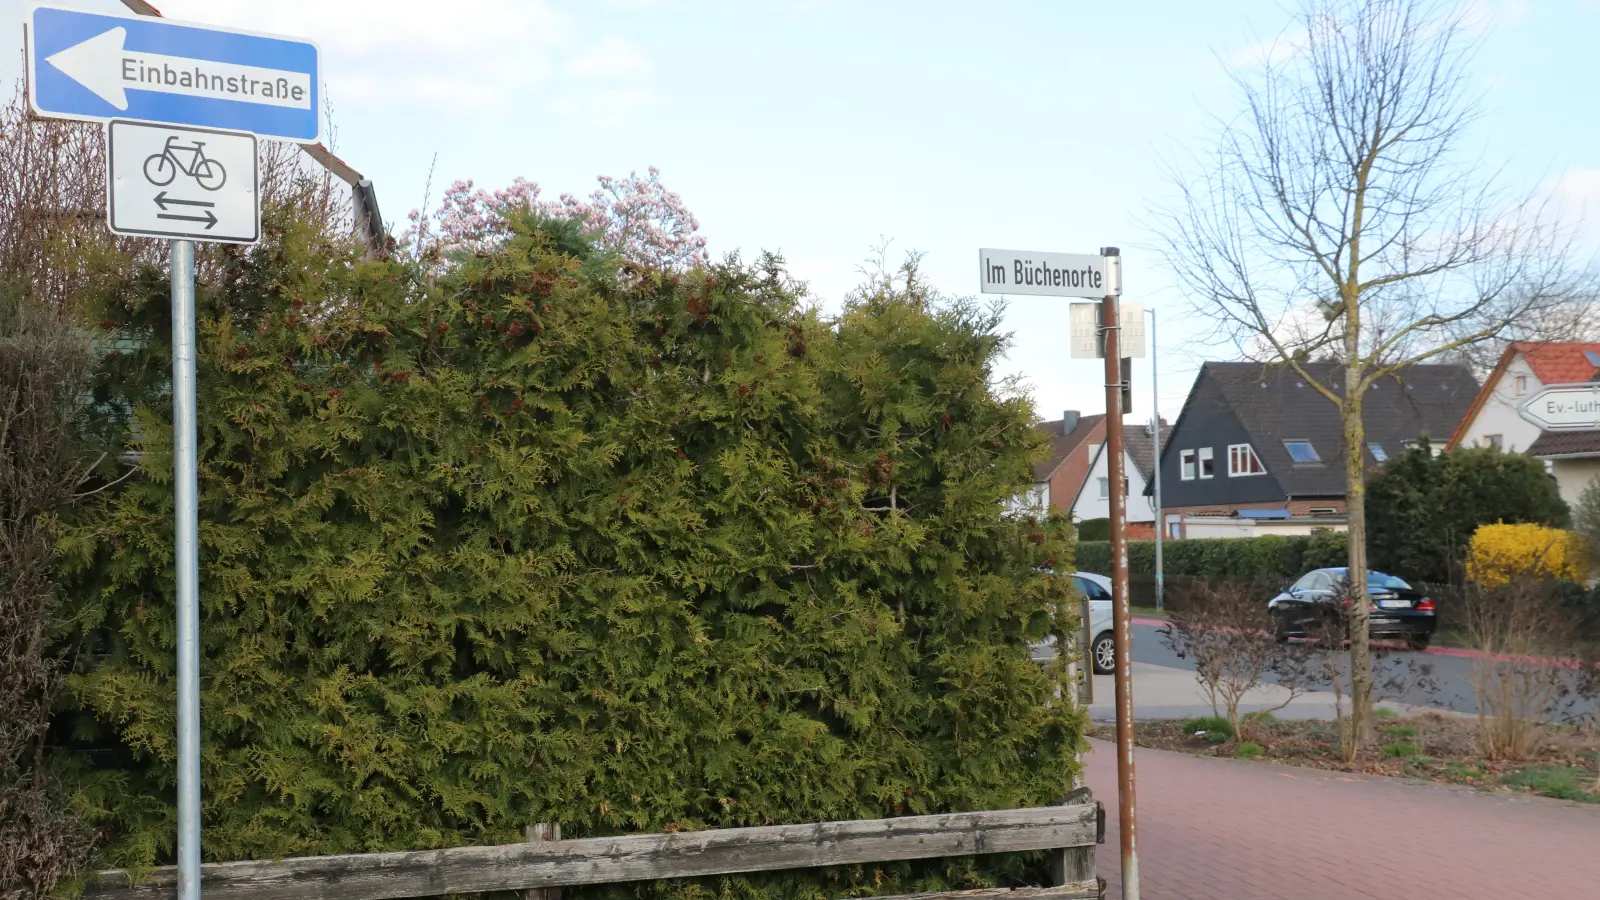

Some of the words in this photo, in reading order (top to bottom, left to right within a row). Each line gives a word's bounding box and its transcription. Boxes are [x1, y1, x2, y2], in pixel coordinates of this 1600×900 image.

[121, 58, 304, 101] Einbahnstraße
[986, 258, 1006, 284] Im
[1014, 259, 1102, 289] Büchenorte
